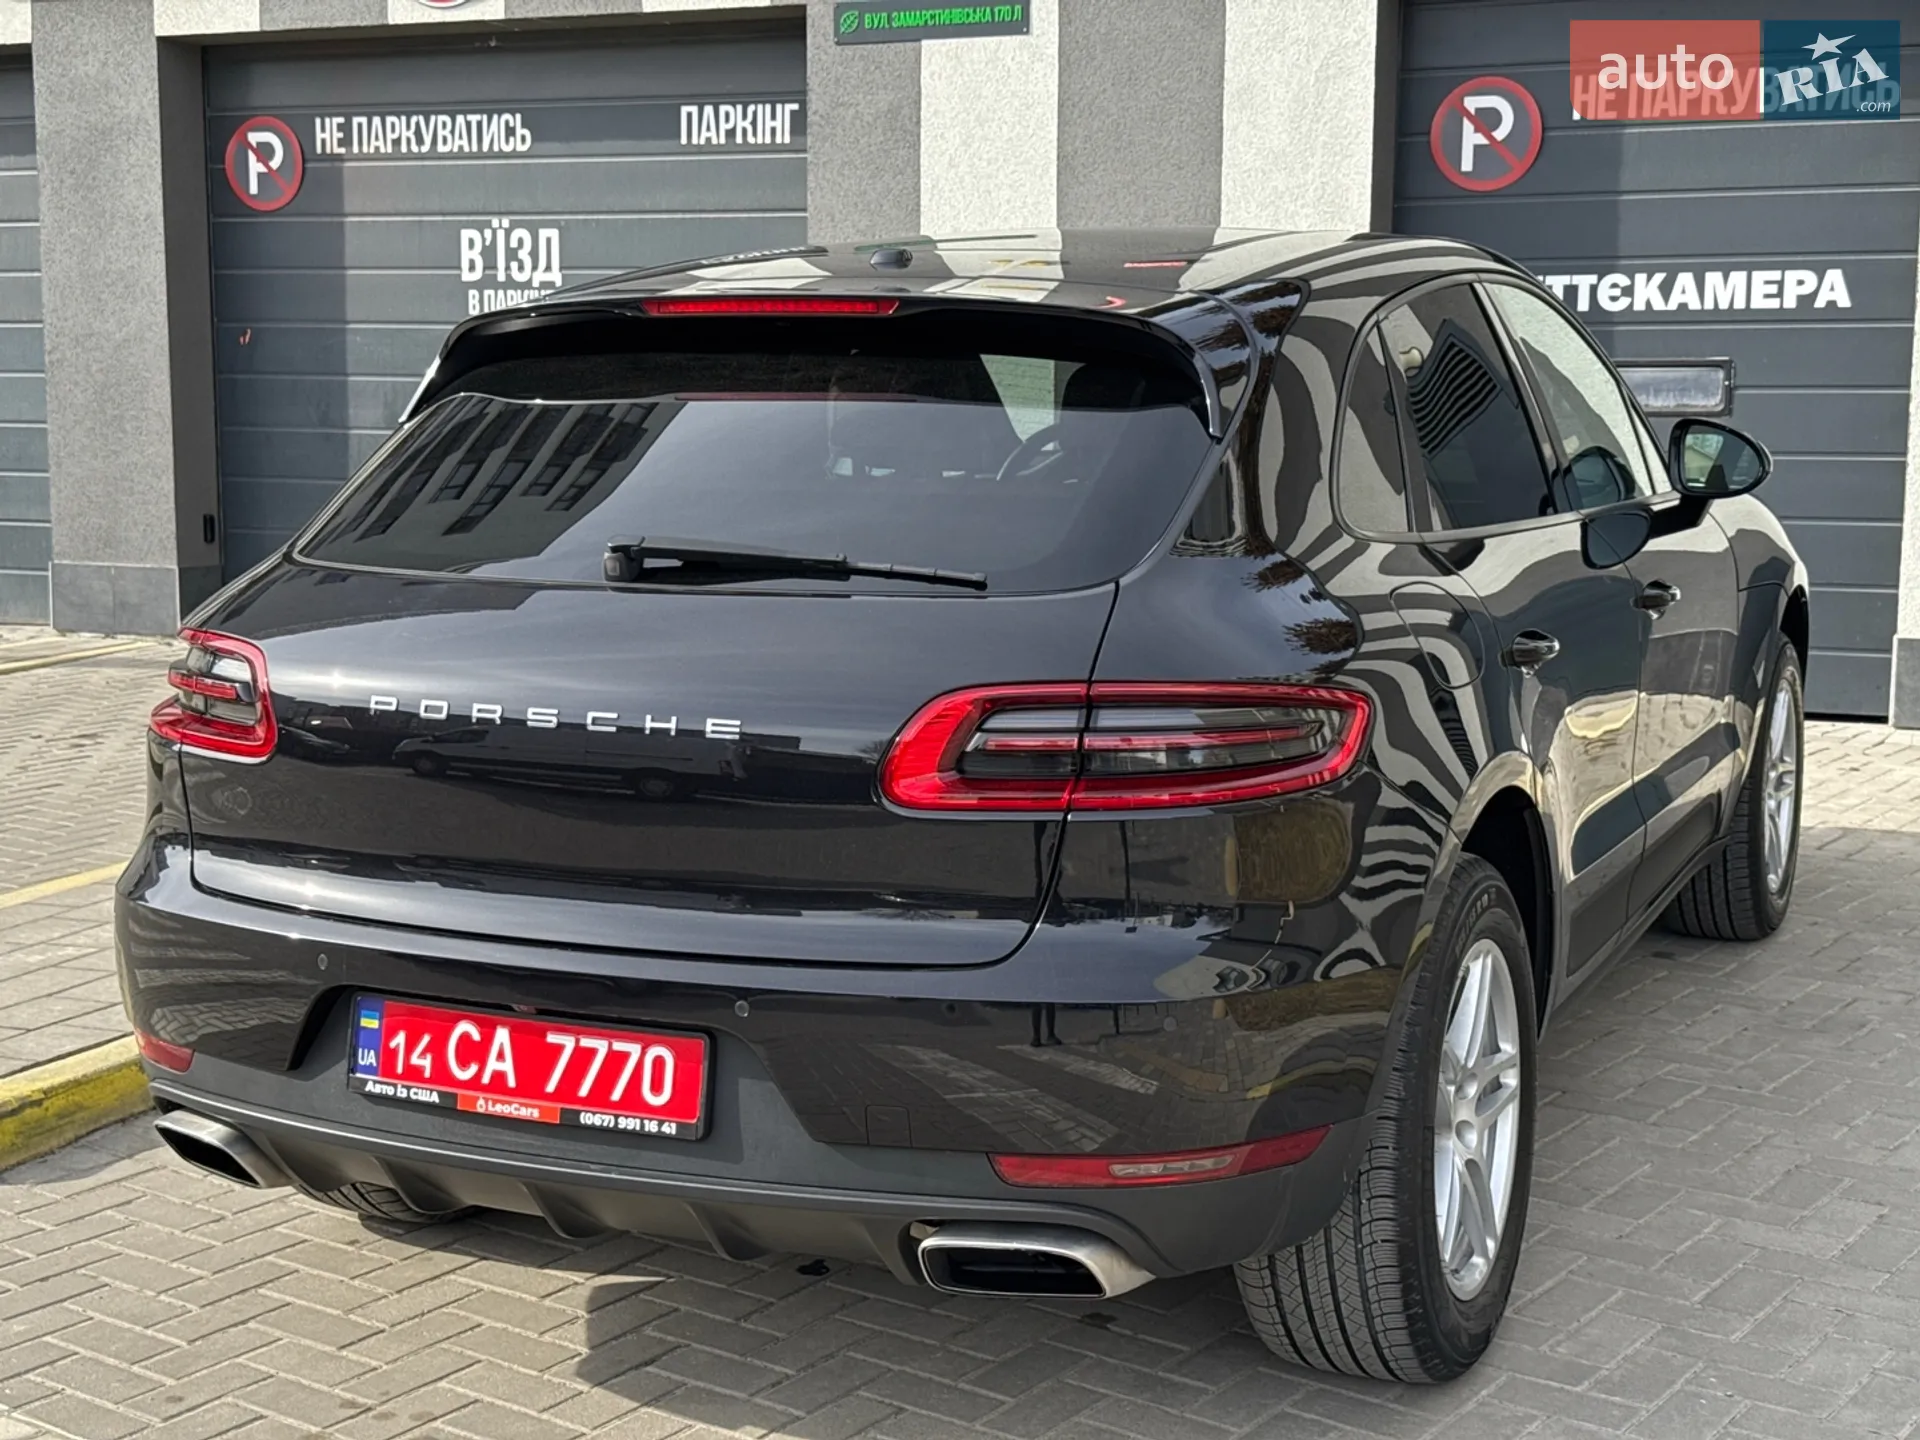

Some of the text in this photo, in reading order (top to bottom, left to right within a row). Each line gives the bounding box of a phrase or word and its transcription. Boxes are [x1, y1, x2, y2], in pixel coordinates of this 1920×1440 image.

[891, 7, 992, 28] ЗАМАРСТИНІВСЬКА
[994, 6, 1011, 22] 170
[1012, 4, 1022, 21] Л
[315, 113, 532, 154] НЕ ПАРКУВАТИСЬ
[680, 103, 800, 145] ПАРКІНГ
[468, 289, 480, 316] В
[1536, 269, 1851, 312] ТТЄКАМЕРА
[369, 695, 742, 740] PORSCHE
[358, 1049, 377, 1067] UA
[388, 1020, 676, 1106] 14 CA 7770
[365, 1081, 395, 1096] Авто
[409, 1088, 440, 1103] США
[487, 1099, 540, 1119] LeoCars
[579, 1112, 677, 1135] (067) 991 16 41
